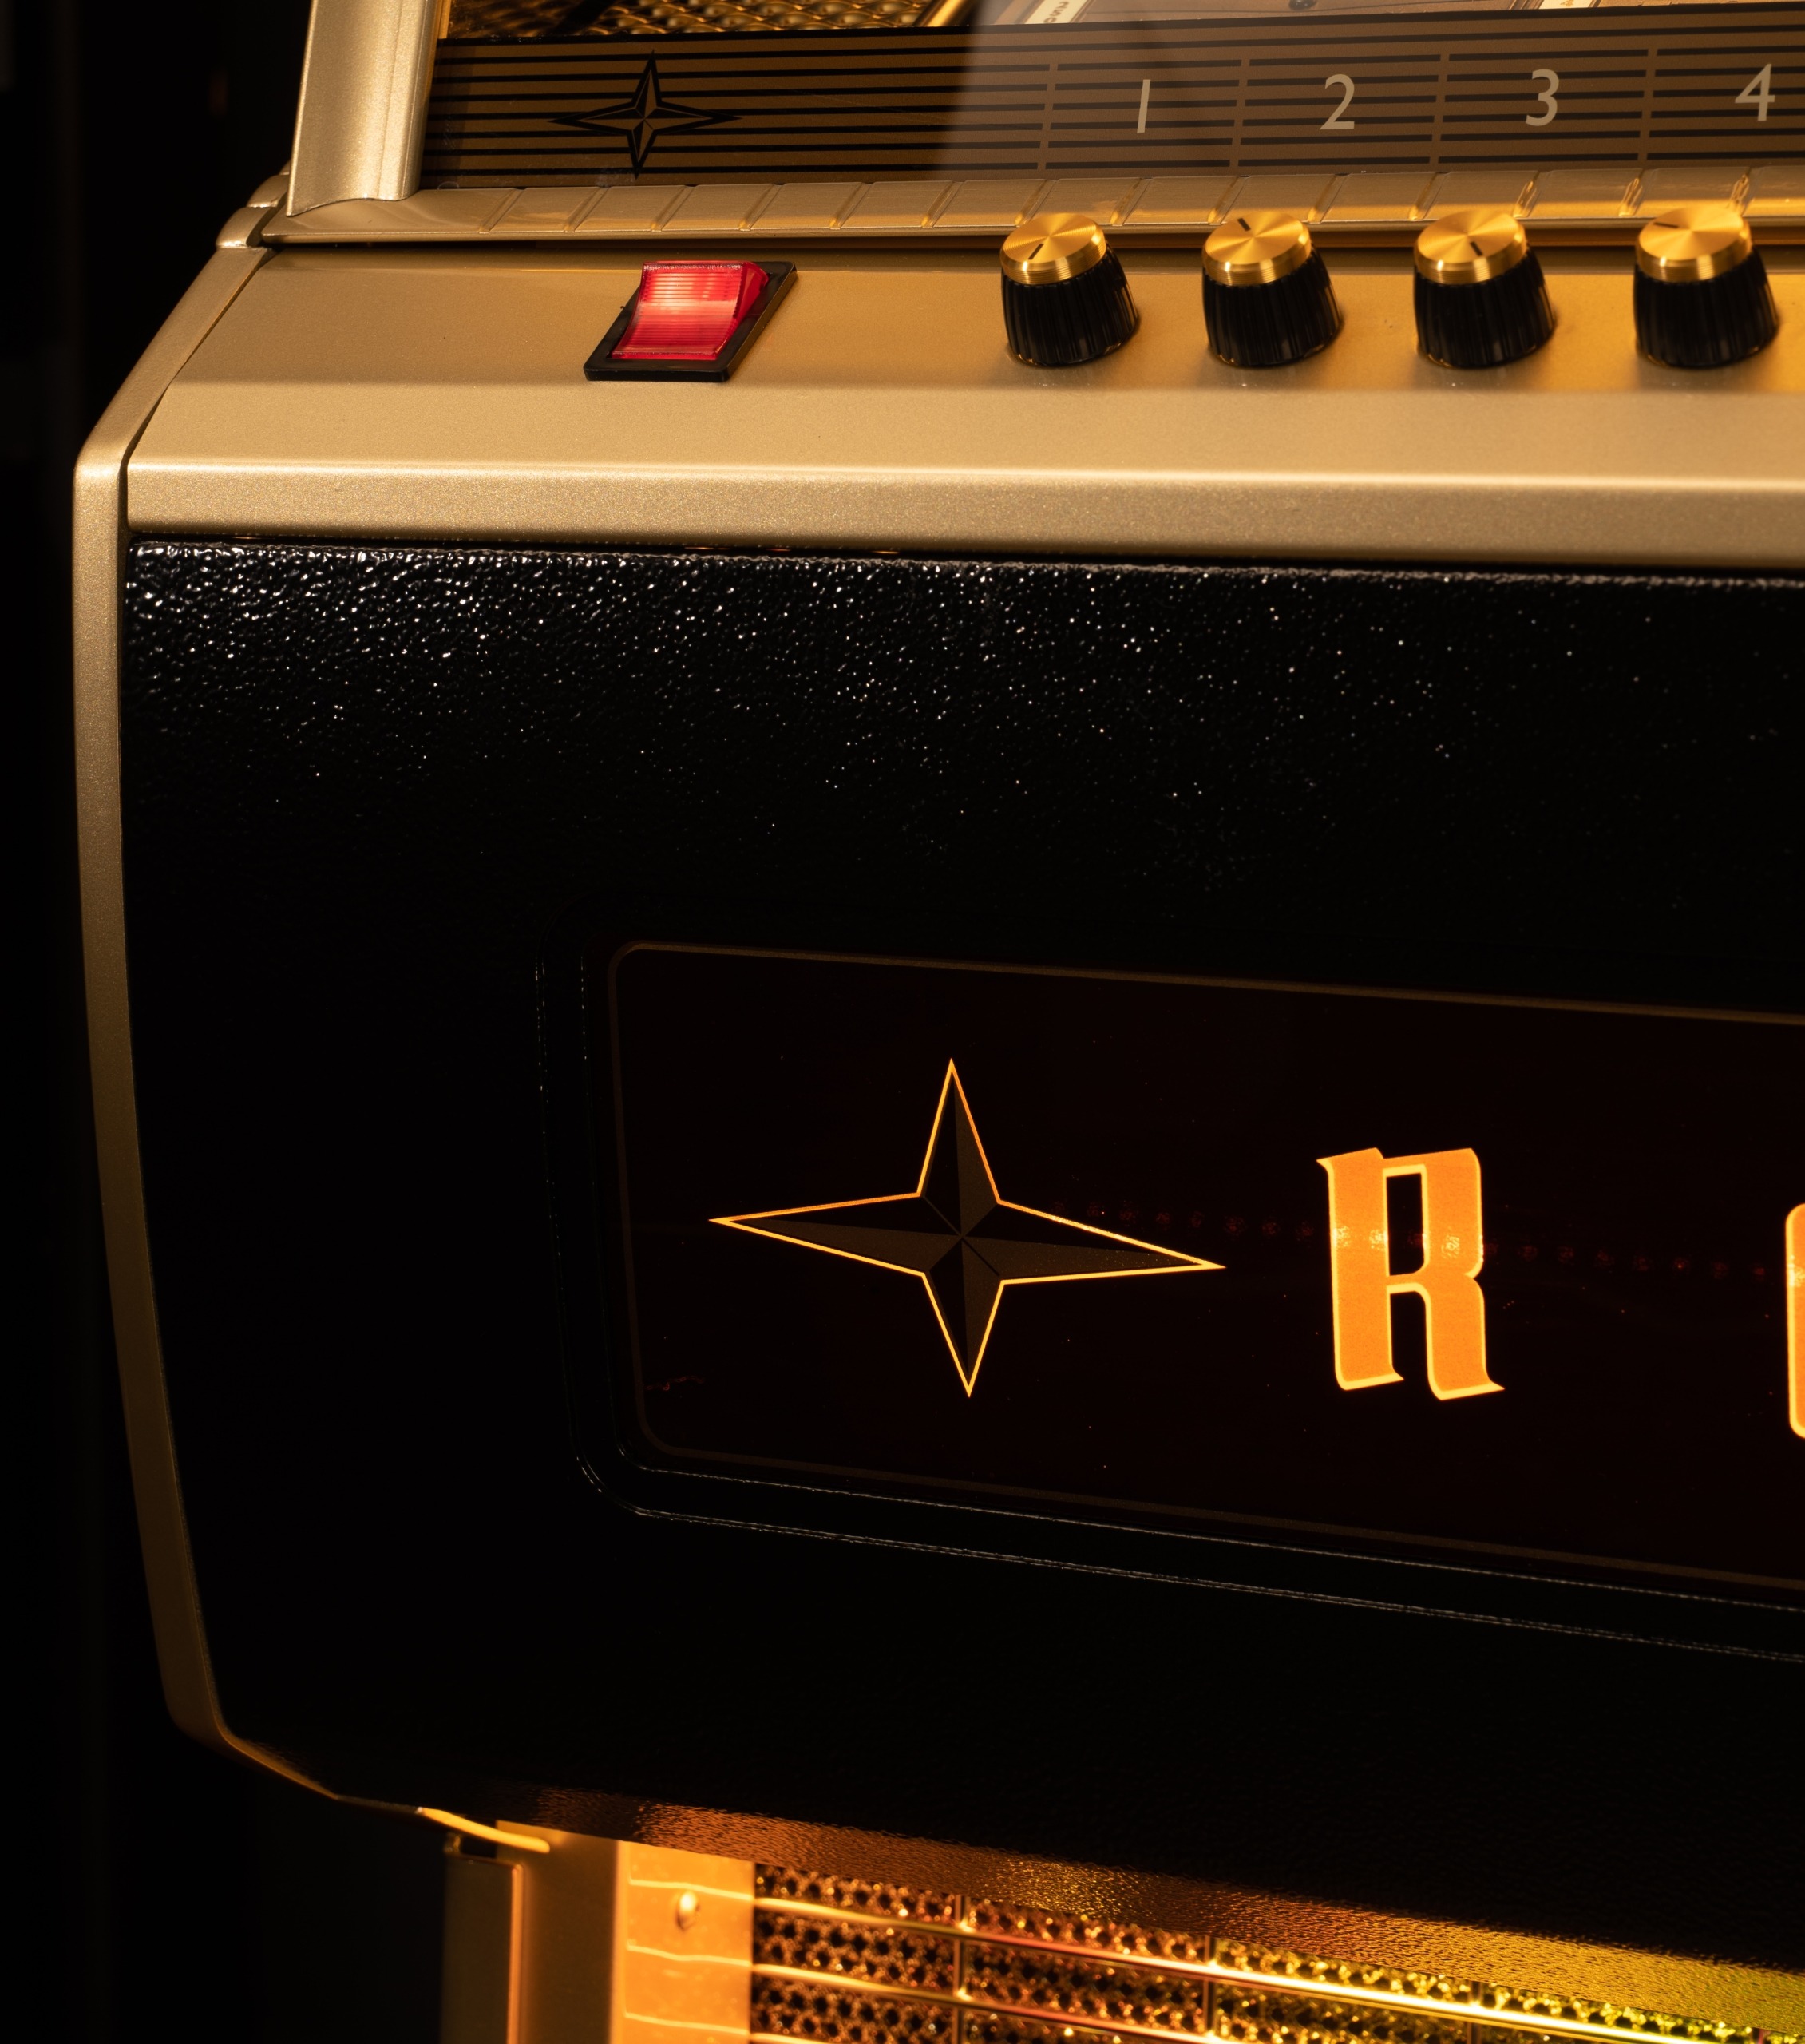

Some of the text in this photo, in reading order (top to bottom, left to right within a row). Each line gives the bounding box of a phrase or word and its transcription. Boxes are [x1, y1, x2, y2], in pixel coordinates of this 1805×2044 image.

[1137, 63, 1775, 133] 1 2 3 4
